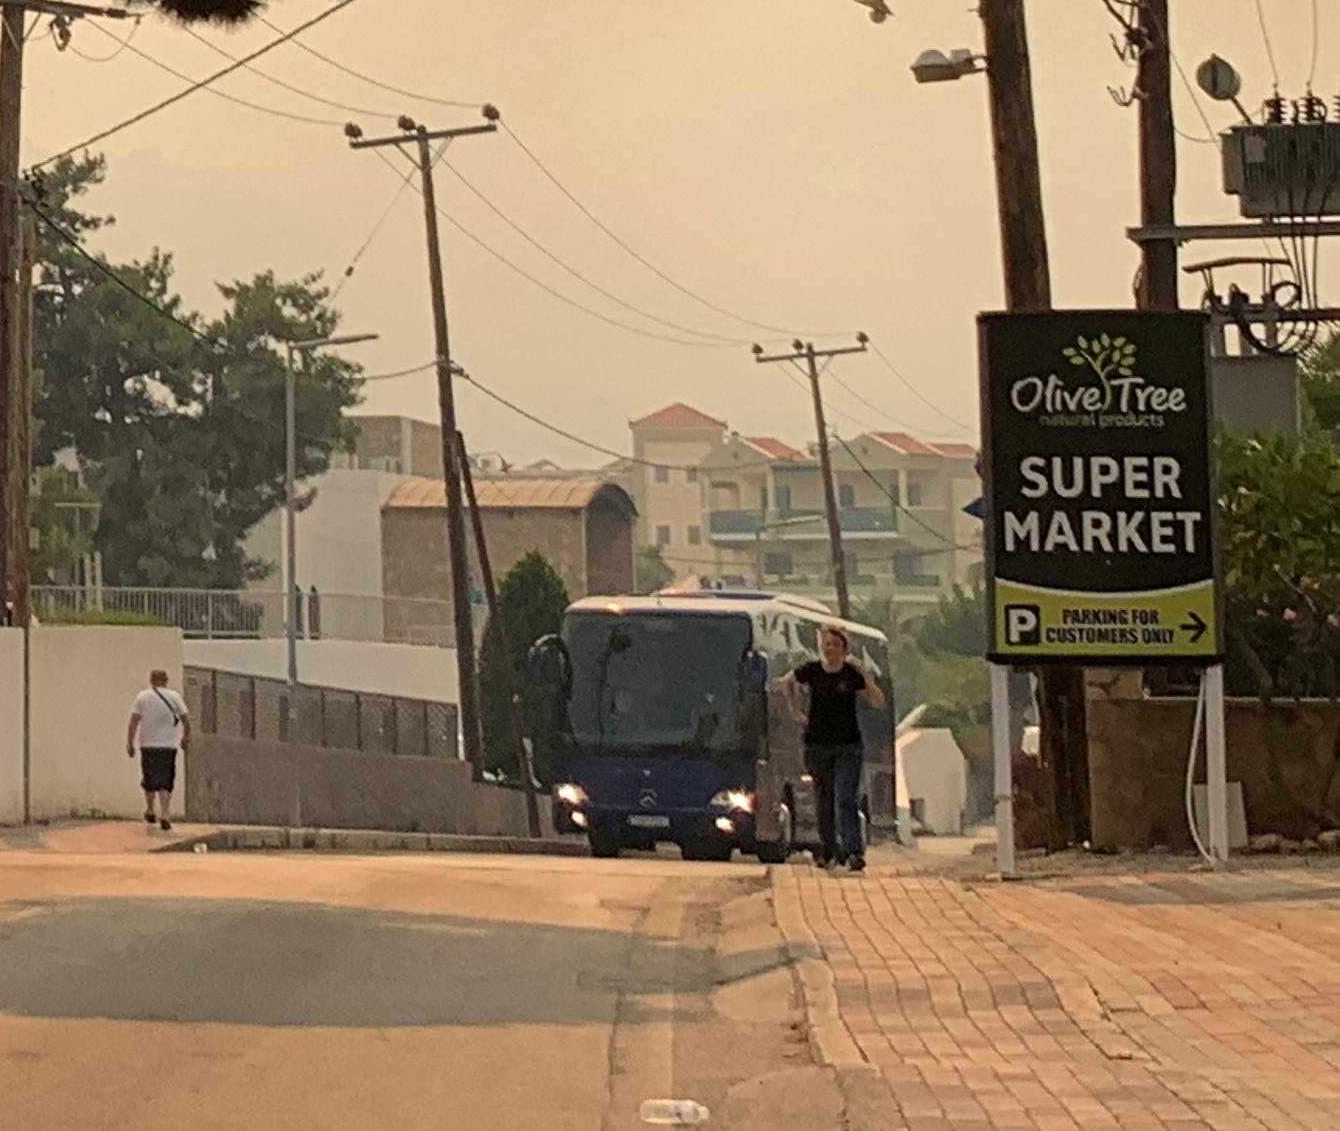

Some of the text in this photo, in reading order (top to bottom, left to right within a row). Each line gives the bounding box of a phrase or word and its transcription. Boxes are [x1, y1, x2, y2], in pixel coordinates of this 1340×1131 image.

[1010, 374, 1187, 413] Olive Tree
[1039, 410, 1166, 429] natural products
[1020, 456, 1183, 498] SUPER
[1004, 510, 1202, 553] MARKET
[1008, 608, 1038, 644] P
[1062, 608, 1160, 625] PARKING FOR
[1045, 627, 1176, 645] CUSTOMERS ONLY
